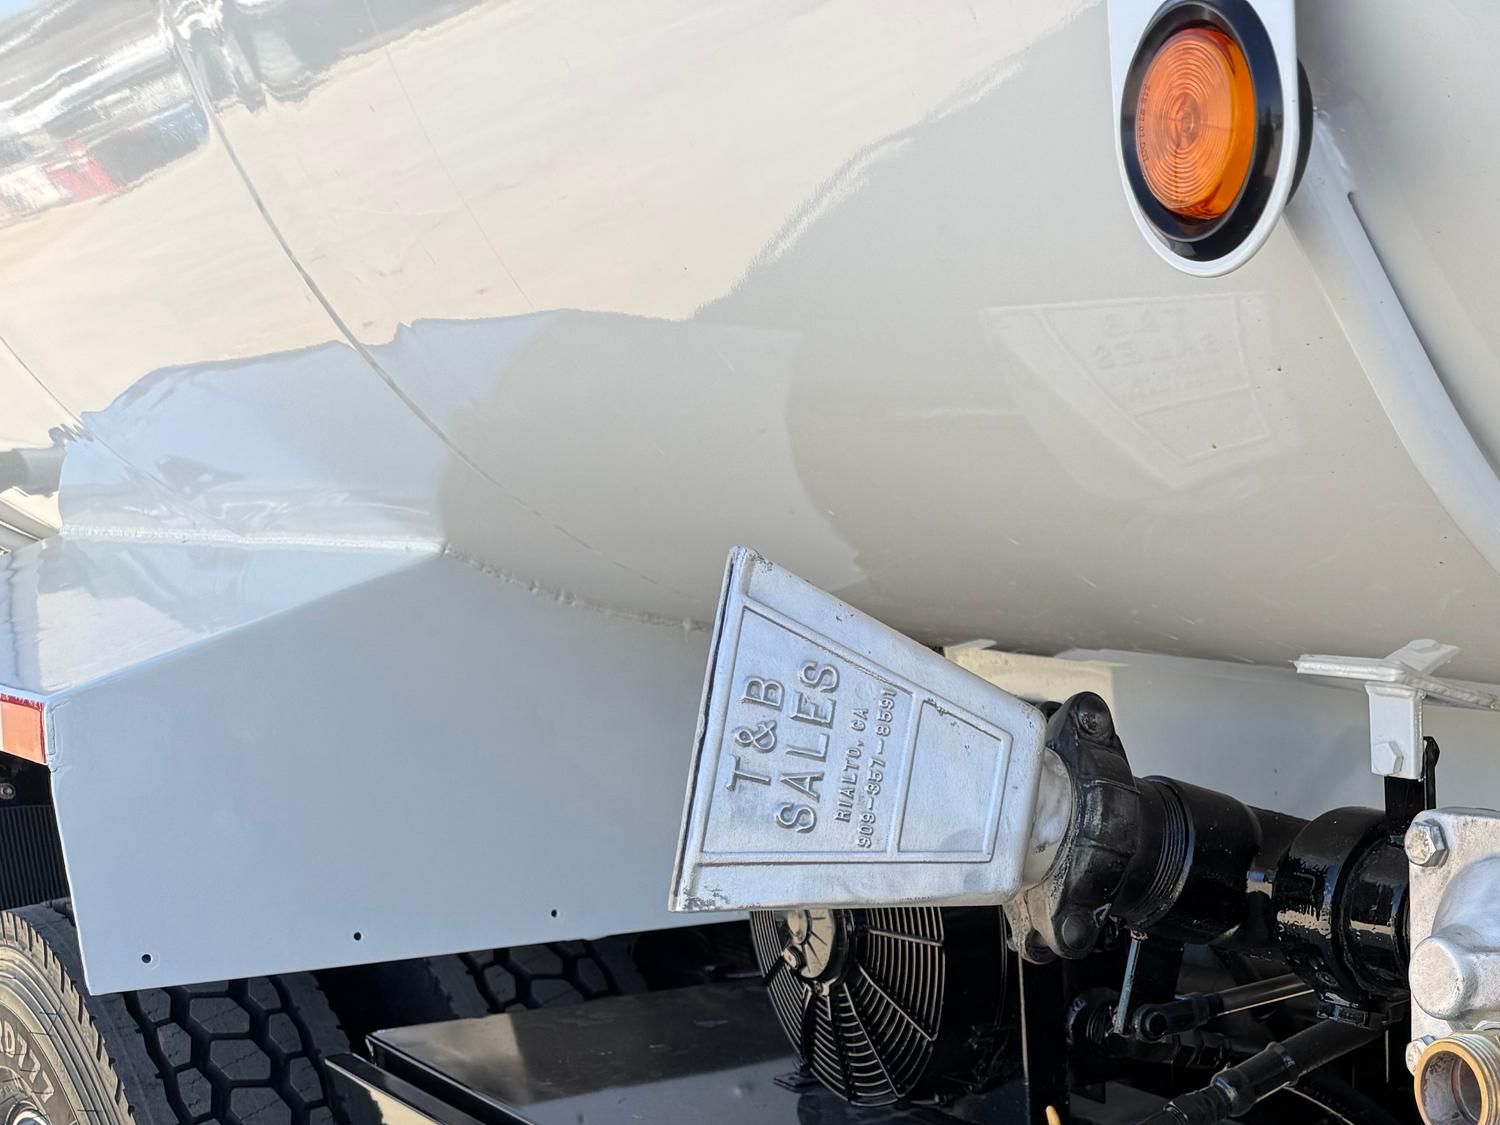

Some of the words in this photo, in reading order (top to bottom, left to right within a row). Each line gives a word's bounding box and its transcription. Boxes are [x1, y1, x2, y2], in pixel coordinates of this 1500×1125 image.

[725, 676, 785, 792] T&B
[774, 660, 841, 833] SALES
[850, 706, 870, 732] CA
[0, 1018, 55, 1103] D777
